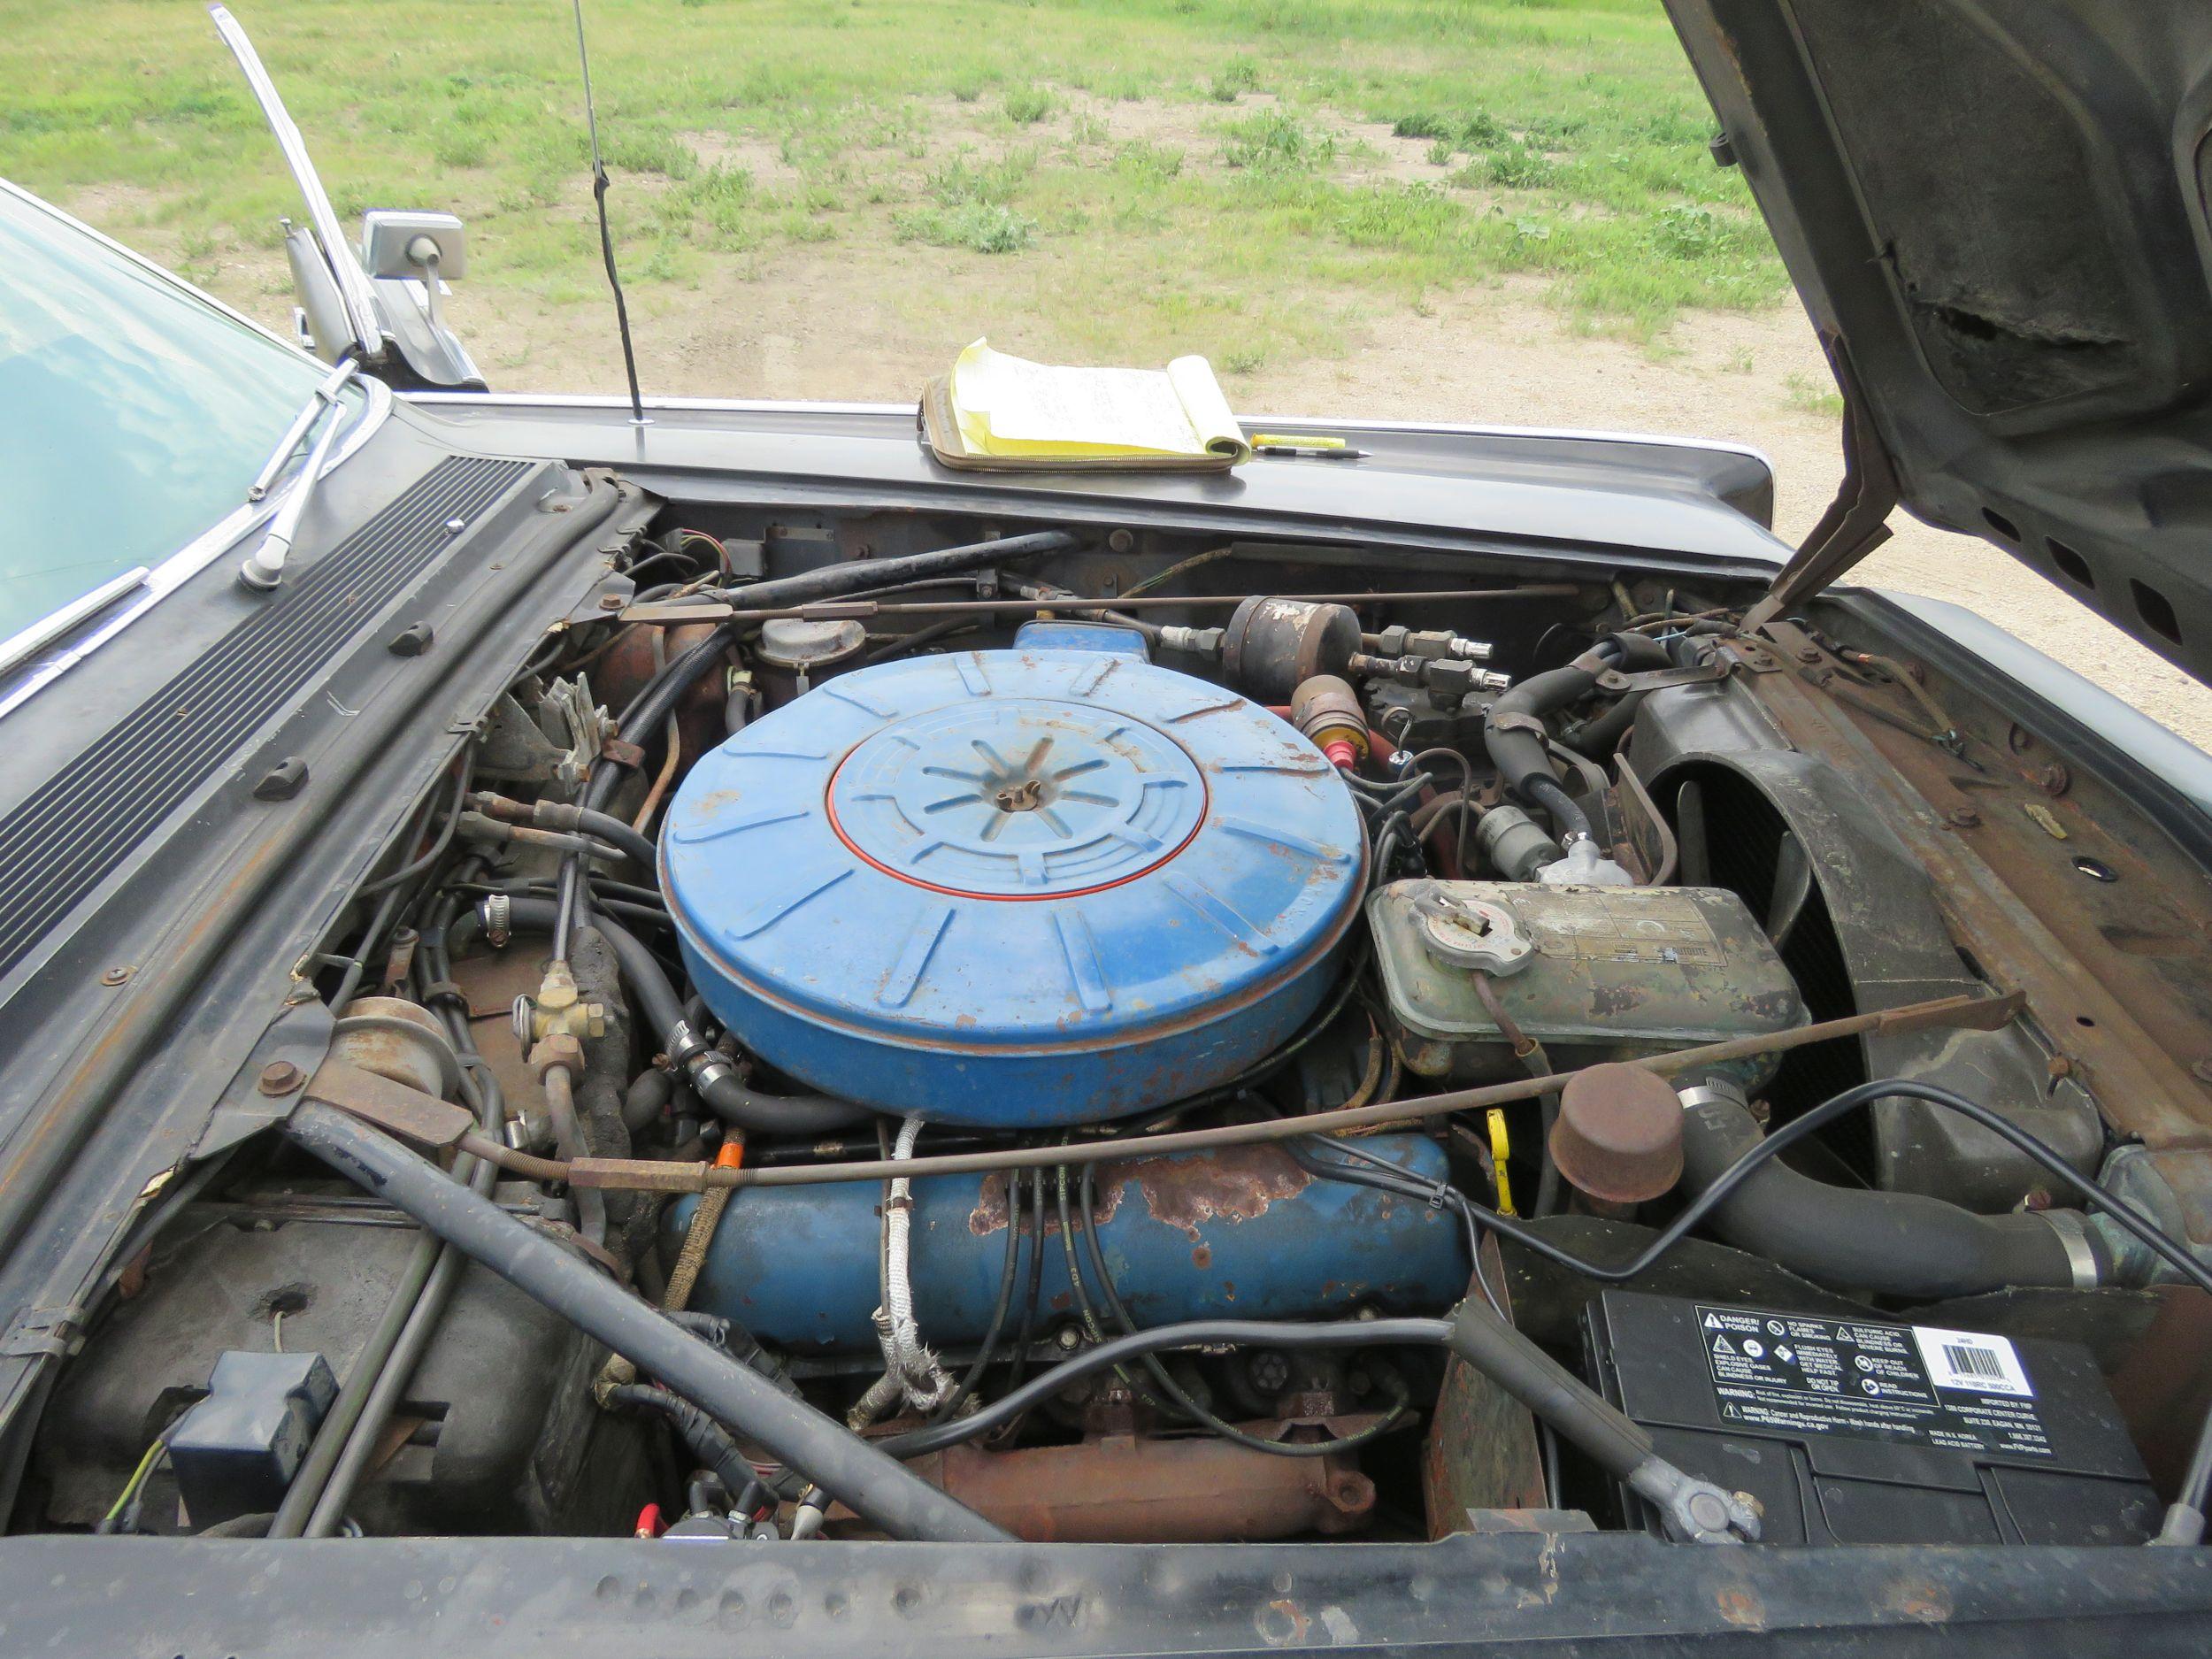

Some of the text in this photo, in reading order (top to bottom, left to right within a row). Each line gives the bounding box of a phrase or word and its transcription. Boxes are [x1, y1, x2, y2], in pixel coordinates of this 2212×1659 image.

[1058, 1165, 1067, 1202] SIPCON
[1719, 1315, 1760, 1325] DANGER/
[1082, 1309, 1102, 1342] SIPCON
[1724, 1323, 1760, 1333] POISON
[1855, 1338, 1893, 1347] BLINDNESS
[1795, 1349, 1838, 1359] IMMEDIATELY
[1715, 1359, 1749, 1368] EXPLOSIVE
[1814, 1363, 1843, 1371] MEDICAL
[1717, 1371, 1754, 1380] BLINDNESS
[1717, 1386, 1756, 1399] WARNING:
[1881, 1388, 1928, 1398] INSTRUCTIONS
[1980, 1398, 2009, 1407] IMPORTED
[1740, 1405, 1770, 1416] WARNING:
[1770, 1409, 1788, 1417] Cancer
[1798, 1412, 1832, 1422] Reproductive
[1957, 1406, 1993, 1416] CORPORATE
[1993, 1409, 2016, 1417] CENTER
[1742, 1415, 1829, 1431] www.P65Warnings.ca.gov
